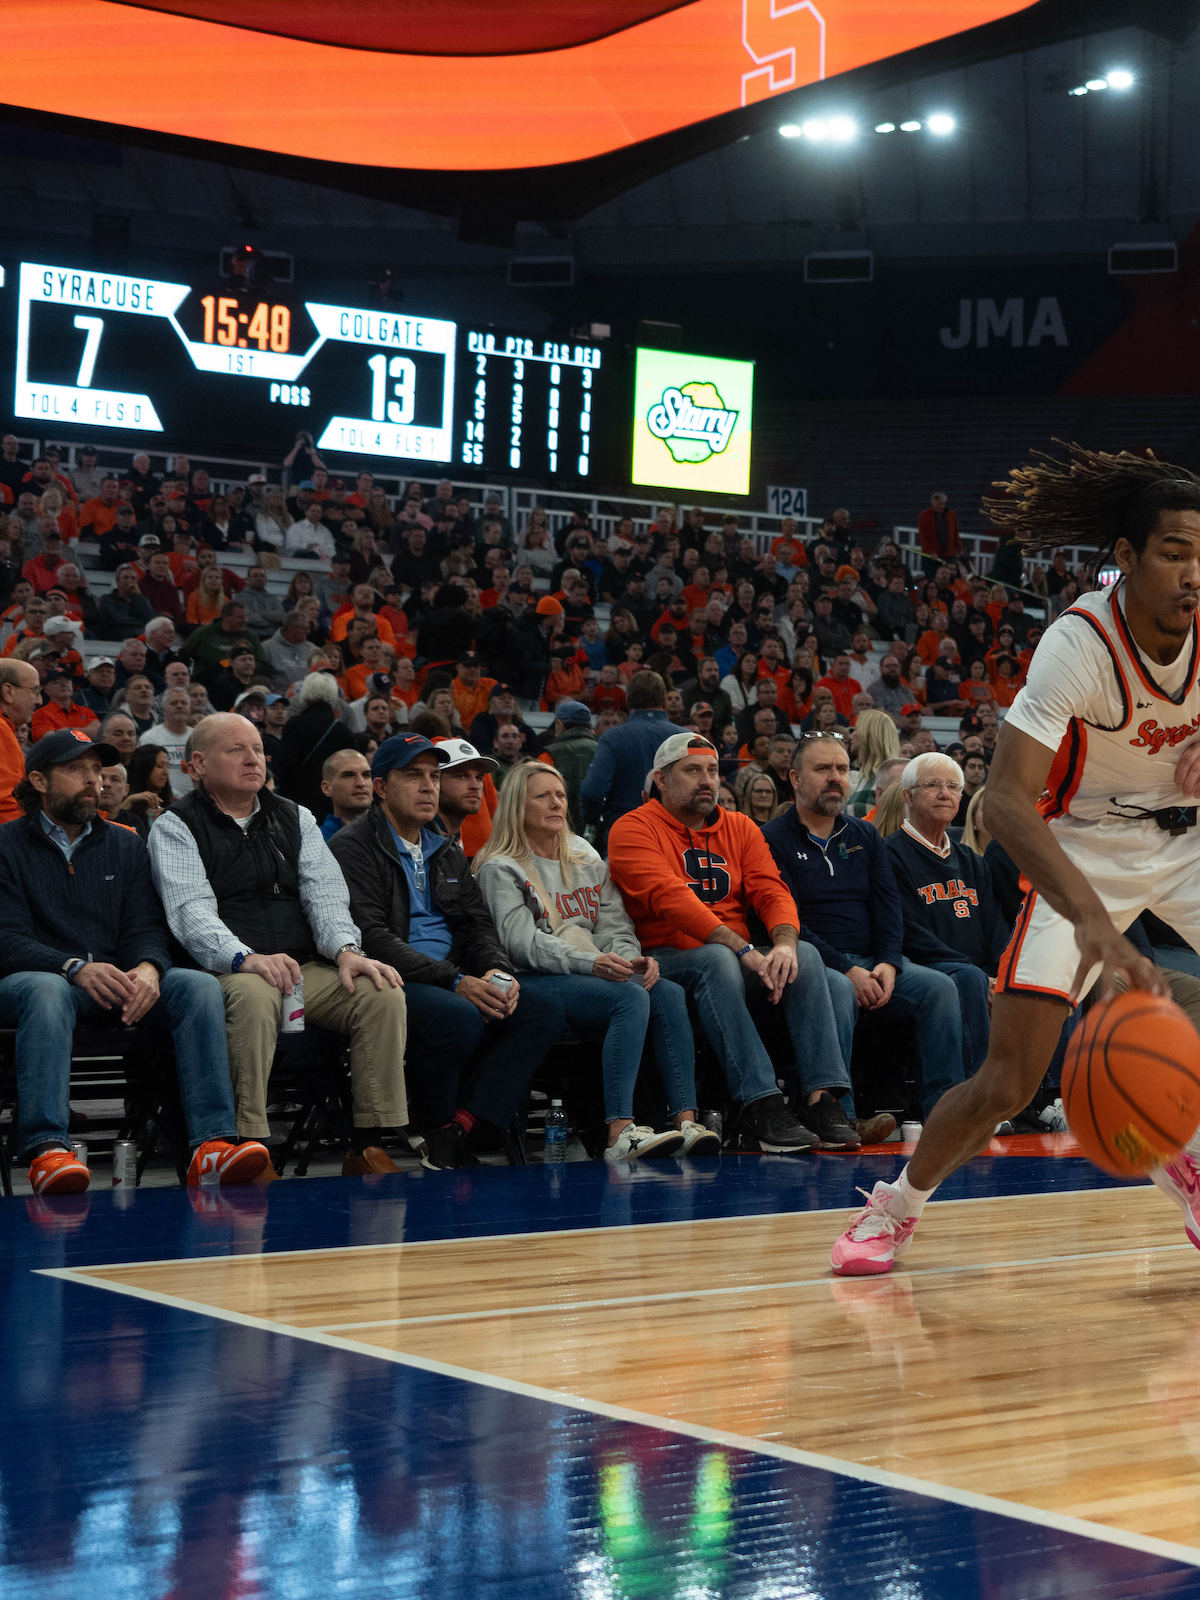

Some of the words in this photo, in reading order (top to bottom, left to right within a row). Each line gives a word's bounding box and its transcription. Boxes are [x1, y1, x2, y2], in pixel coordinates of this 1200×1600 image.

[43, 271, 155, 311] SYRACUSE
[201, 295, 291, 353] 15:48
[340, 312, 424, 347] COLGATE
[940, 297, 1069, 349] JMA
[73, 314, 104, 388] 7
[228, 353, 254, 375] 1ST
[367, 353, 417, 425] 13
[475, 354, 487, 376] 2
[513, 359, 524, 380] 3
[582, 367, 593, 389] 3
[31, 393, 60, 414] TOL
[71, 398, 78, 415] 4
[95, 400, 125, 421] FLS
[270, 382, 311, 407] POSS
[474, 399, 486, 420] 5
[511, 403, 523, 425] 5
[475, 379, 487, 400] 4
[512, 383, 523, 404] 3
[584, 392, 592, 413] 1
[340, 427, 365, 448] TOL
[375, 432, 381, 448] 4
[466, 420, 485, 442] 14
[510, 425, 522, 447] 2
[582, 434, 590, 455] 1
[647, 387, 738, 453] Starry
[462, 441, 484, 465] 55
[549, 452, 558, 473] 1
[770, 488, 805, 518] 124
[681, 847, 731, 903] S
[953, 900, 970, 918] S
